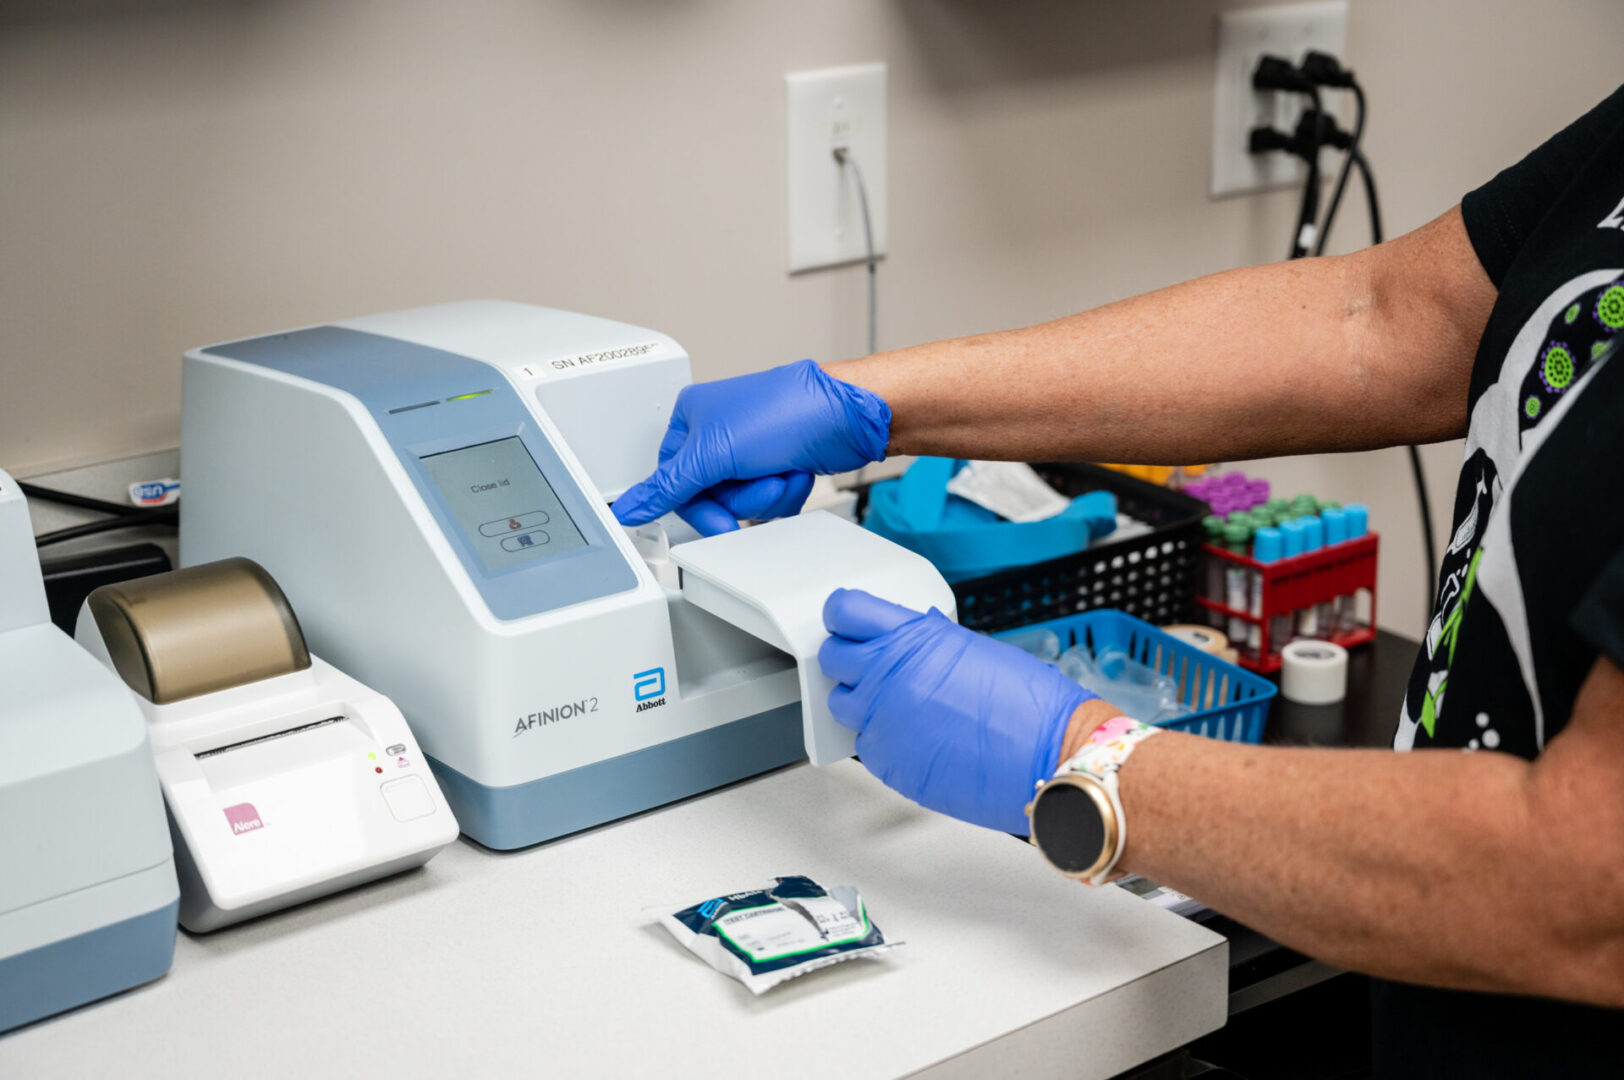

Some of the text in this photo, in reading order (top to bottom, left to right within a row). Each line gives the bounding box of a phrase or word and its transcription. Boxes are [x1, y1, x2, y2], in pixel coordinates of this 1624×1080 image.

[552, 359, 575, 370] SN
[470, 478, 510, 493] Close lid
[590, 697, 599, 712] 2
[636, 697, 666, 712] Abbott
[234, 819, 260, 832] Alere
